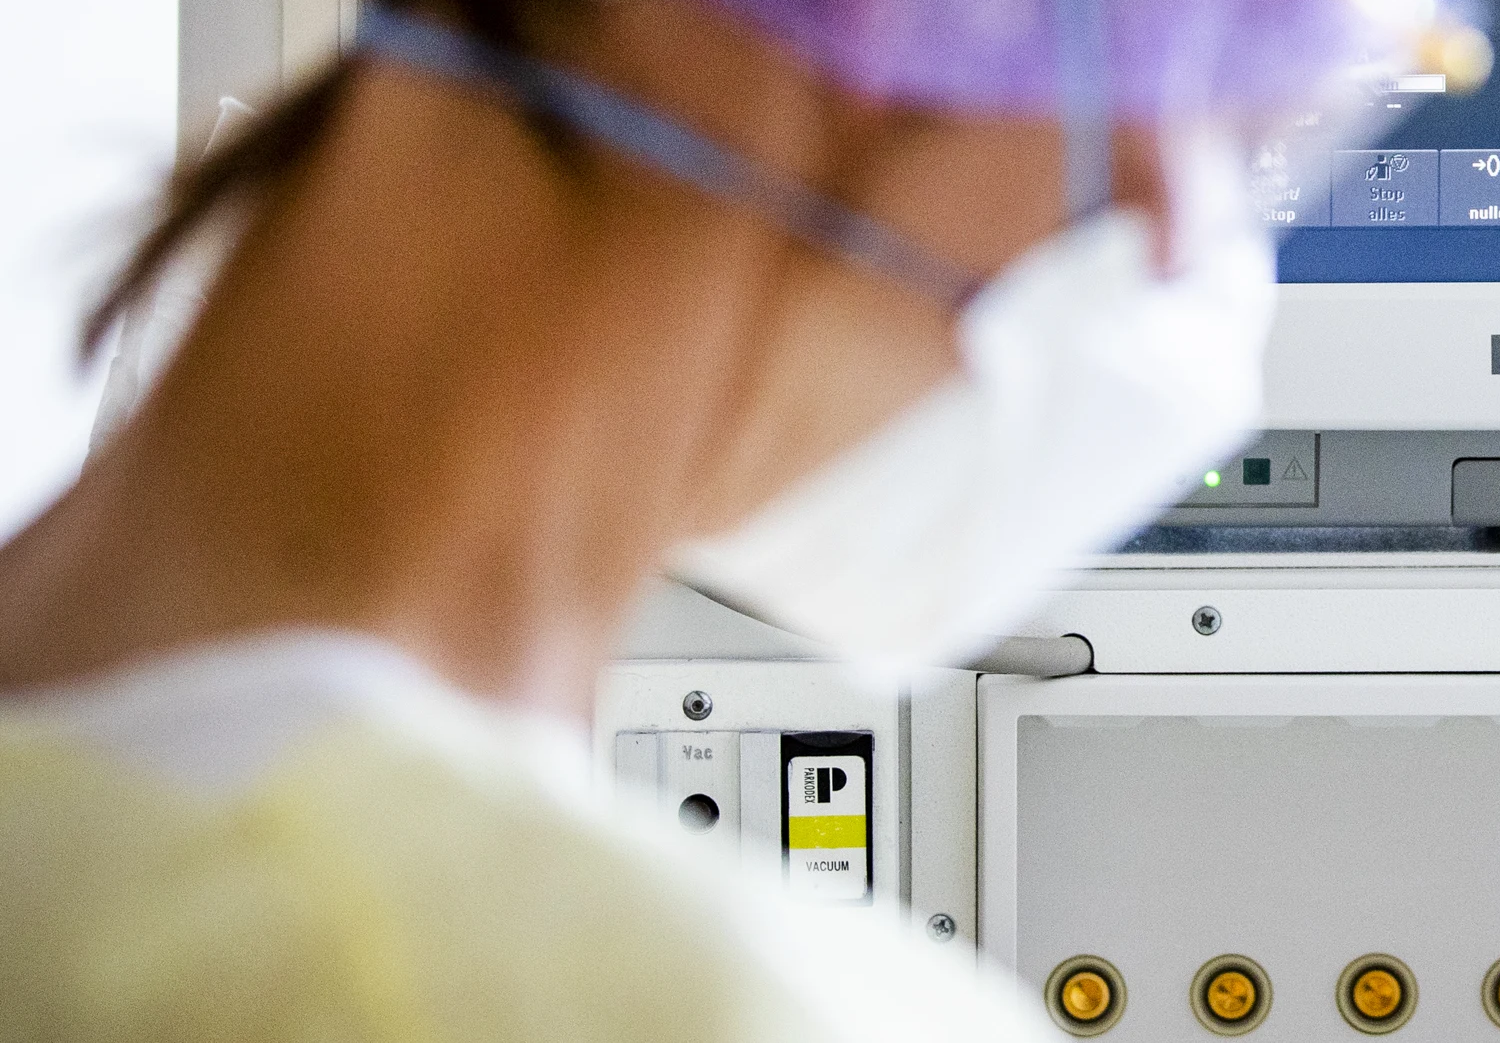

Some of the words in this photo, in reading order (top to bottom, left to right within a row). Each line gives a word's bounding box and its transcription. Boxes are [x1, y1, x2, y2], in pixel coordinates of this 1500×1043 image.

[1370, 186, 1405, 203] Stop
[1368, 208, 1406, 221] alles
[682, 745, 713, 760] Vac
[804, 766, 815, 804] PARKODEX
[806, 860, 850, 872] VACUUM
